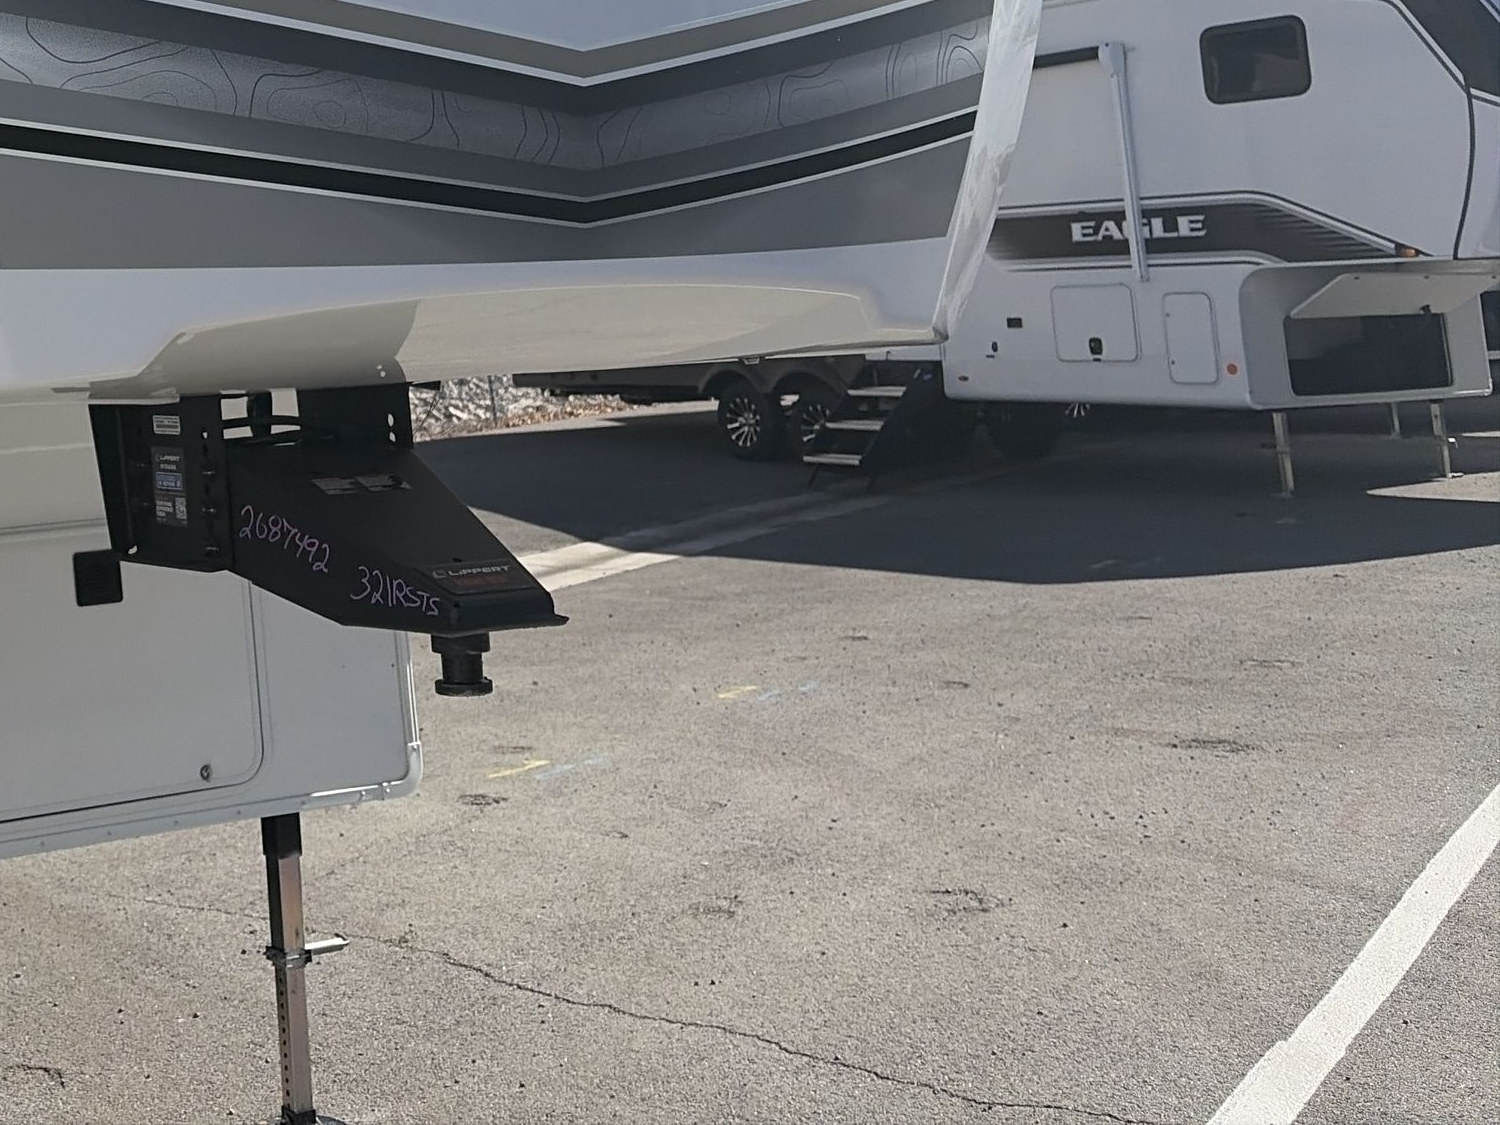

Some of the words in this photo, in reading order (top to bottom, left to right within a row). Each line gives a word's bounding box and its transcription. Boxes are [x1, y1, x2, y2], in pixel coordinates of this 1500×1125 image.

[239, 505, 330, 573] 2687492
[350, 566, 440, 615] 321RSTS
[448, 565, 509, 576] LIPPERT
